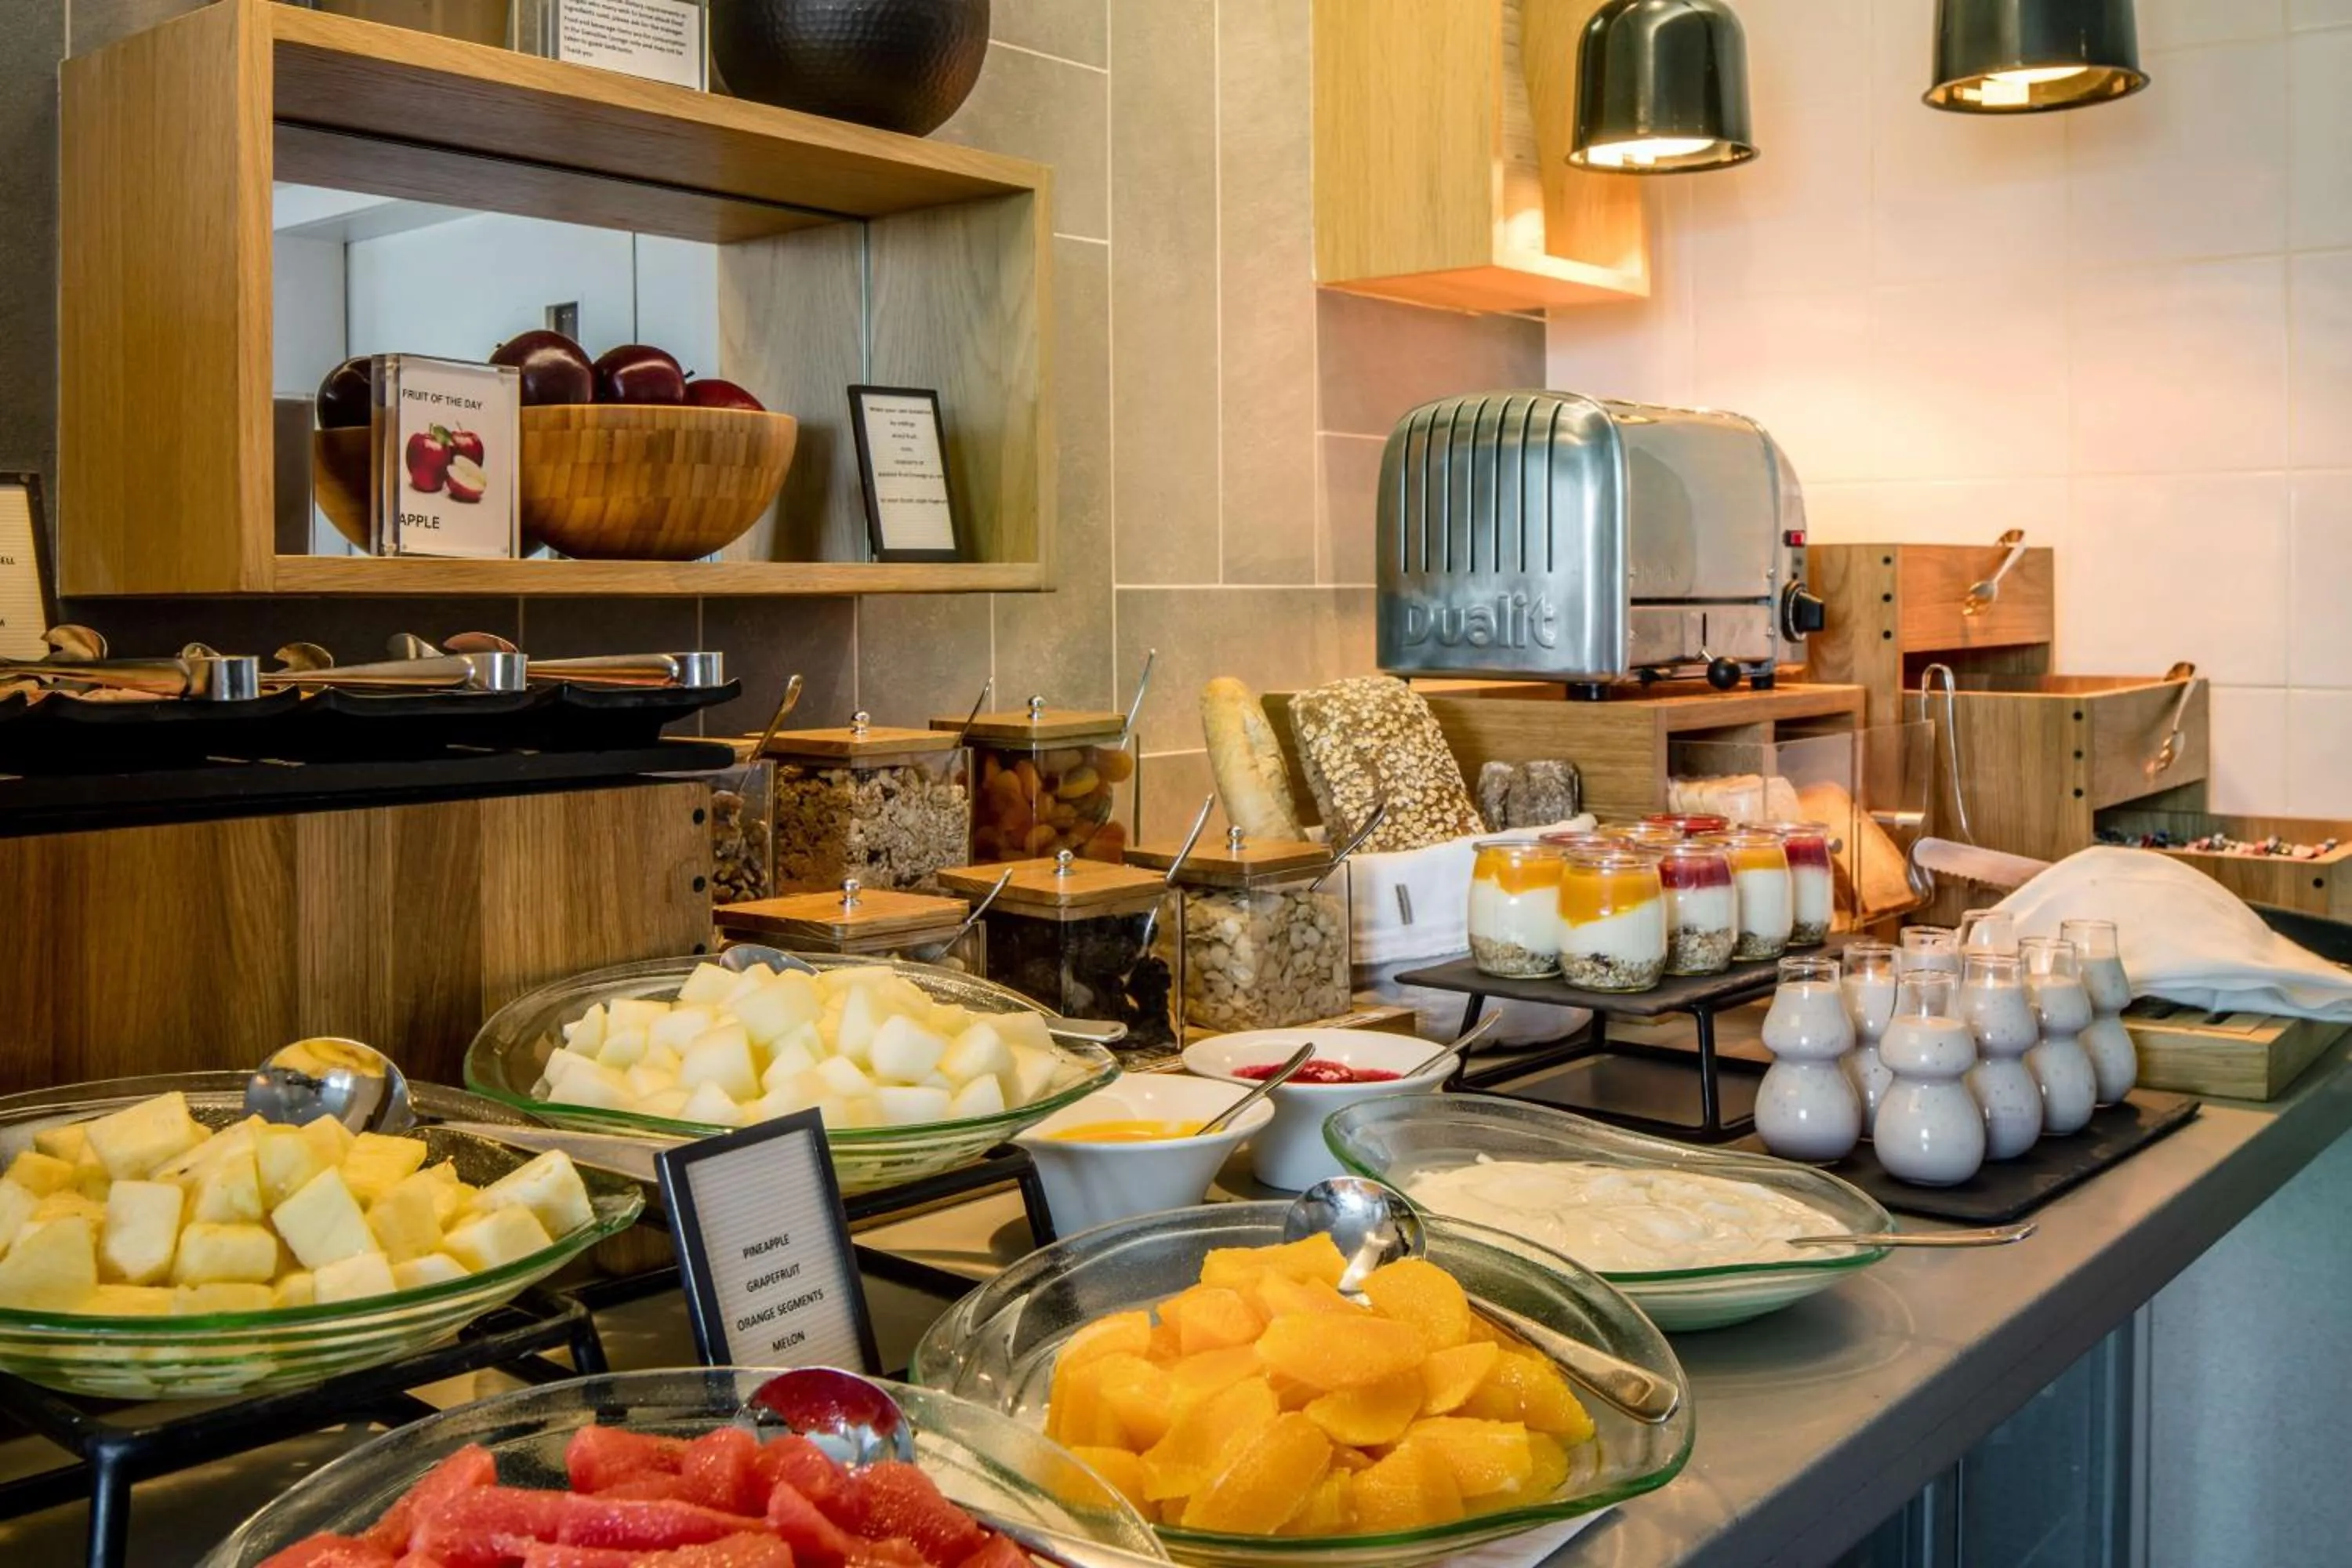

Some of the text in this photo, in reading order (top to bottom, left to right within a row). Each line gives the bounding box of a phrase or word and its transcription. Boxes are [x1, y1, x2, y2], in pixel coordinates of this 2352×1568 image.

[402, 389, 483, 410] FRUIT OF THE DAY
[401, 513, 440, 529] APPLE
[1403, 593, 1555, 649] Dualit
[742, 1233, 789, 1259] PINEAPPLE
[746, 1262, 800, 1293] GRAPEFRUIT
[737, 1288, 824, 1331] ORANGE SEGMENTS
[772, 1330, 805, 1353] MELON
